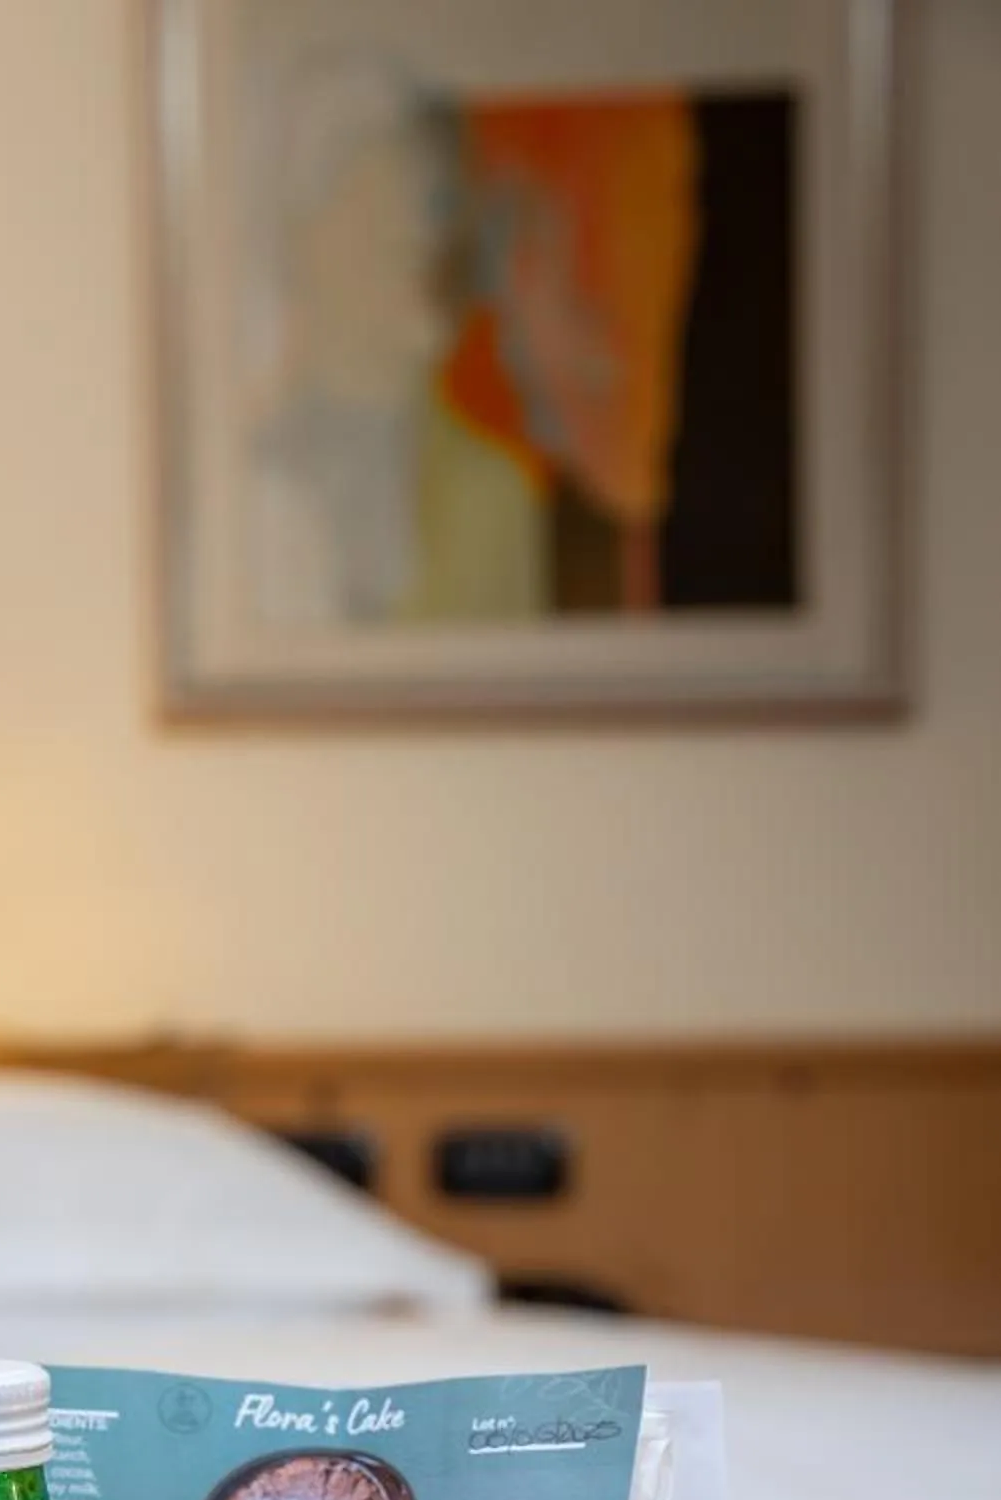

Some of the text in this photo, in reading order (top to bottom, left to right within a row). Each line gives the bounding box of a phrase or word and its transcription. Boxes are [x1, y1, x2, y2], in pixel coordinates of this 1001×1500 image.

[234, 1393, 406, 1436] Flora's Cake
[472, 1417, 495, 1431] Lot
